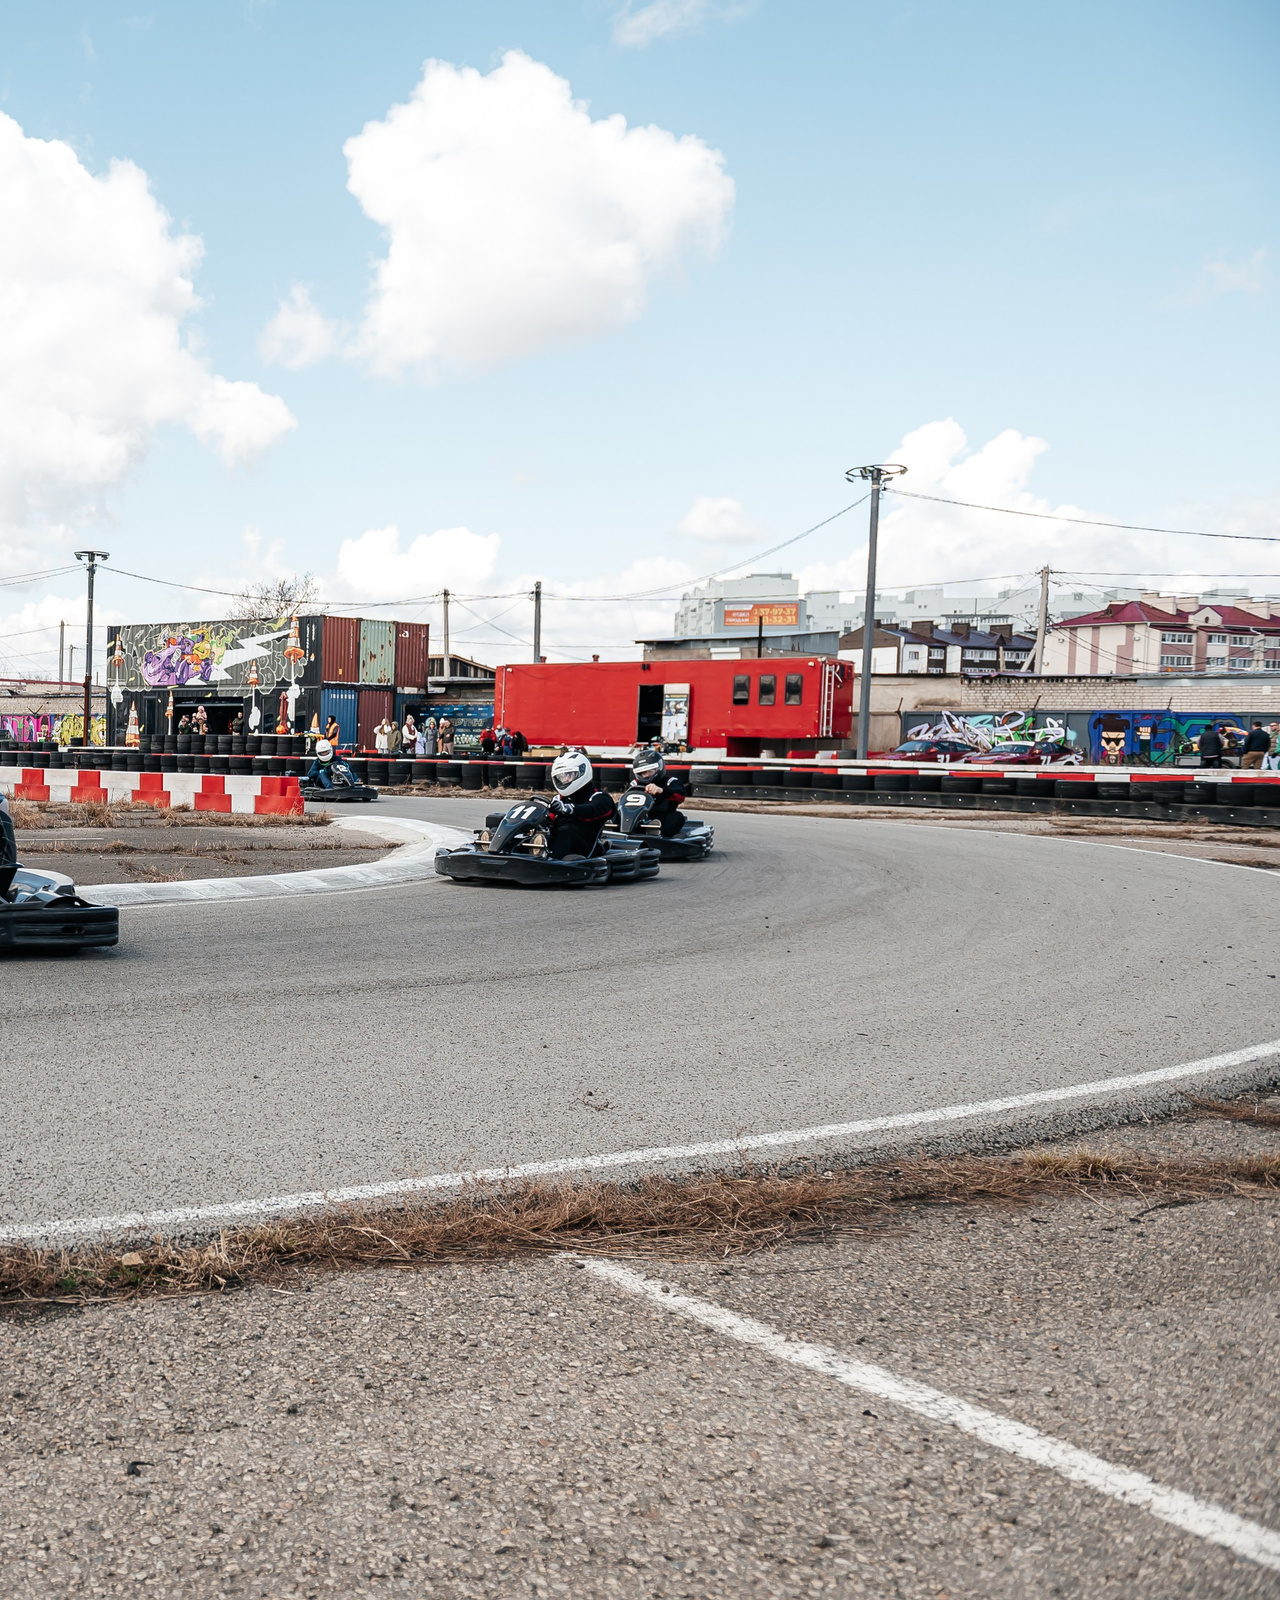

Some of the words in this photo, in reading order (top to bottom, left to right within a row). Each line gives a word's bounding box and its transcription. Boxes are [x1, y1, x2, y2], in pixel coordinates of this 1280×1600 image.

[336, 764, 348, 772] 12
[624, 794, 646, 806] 9
[510, 805, 537, 820] 11
